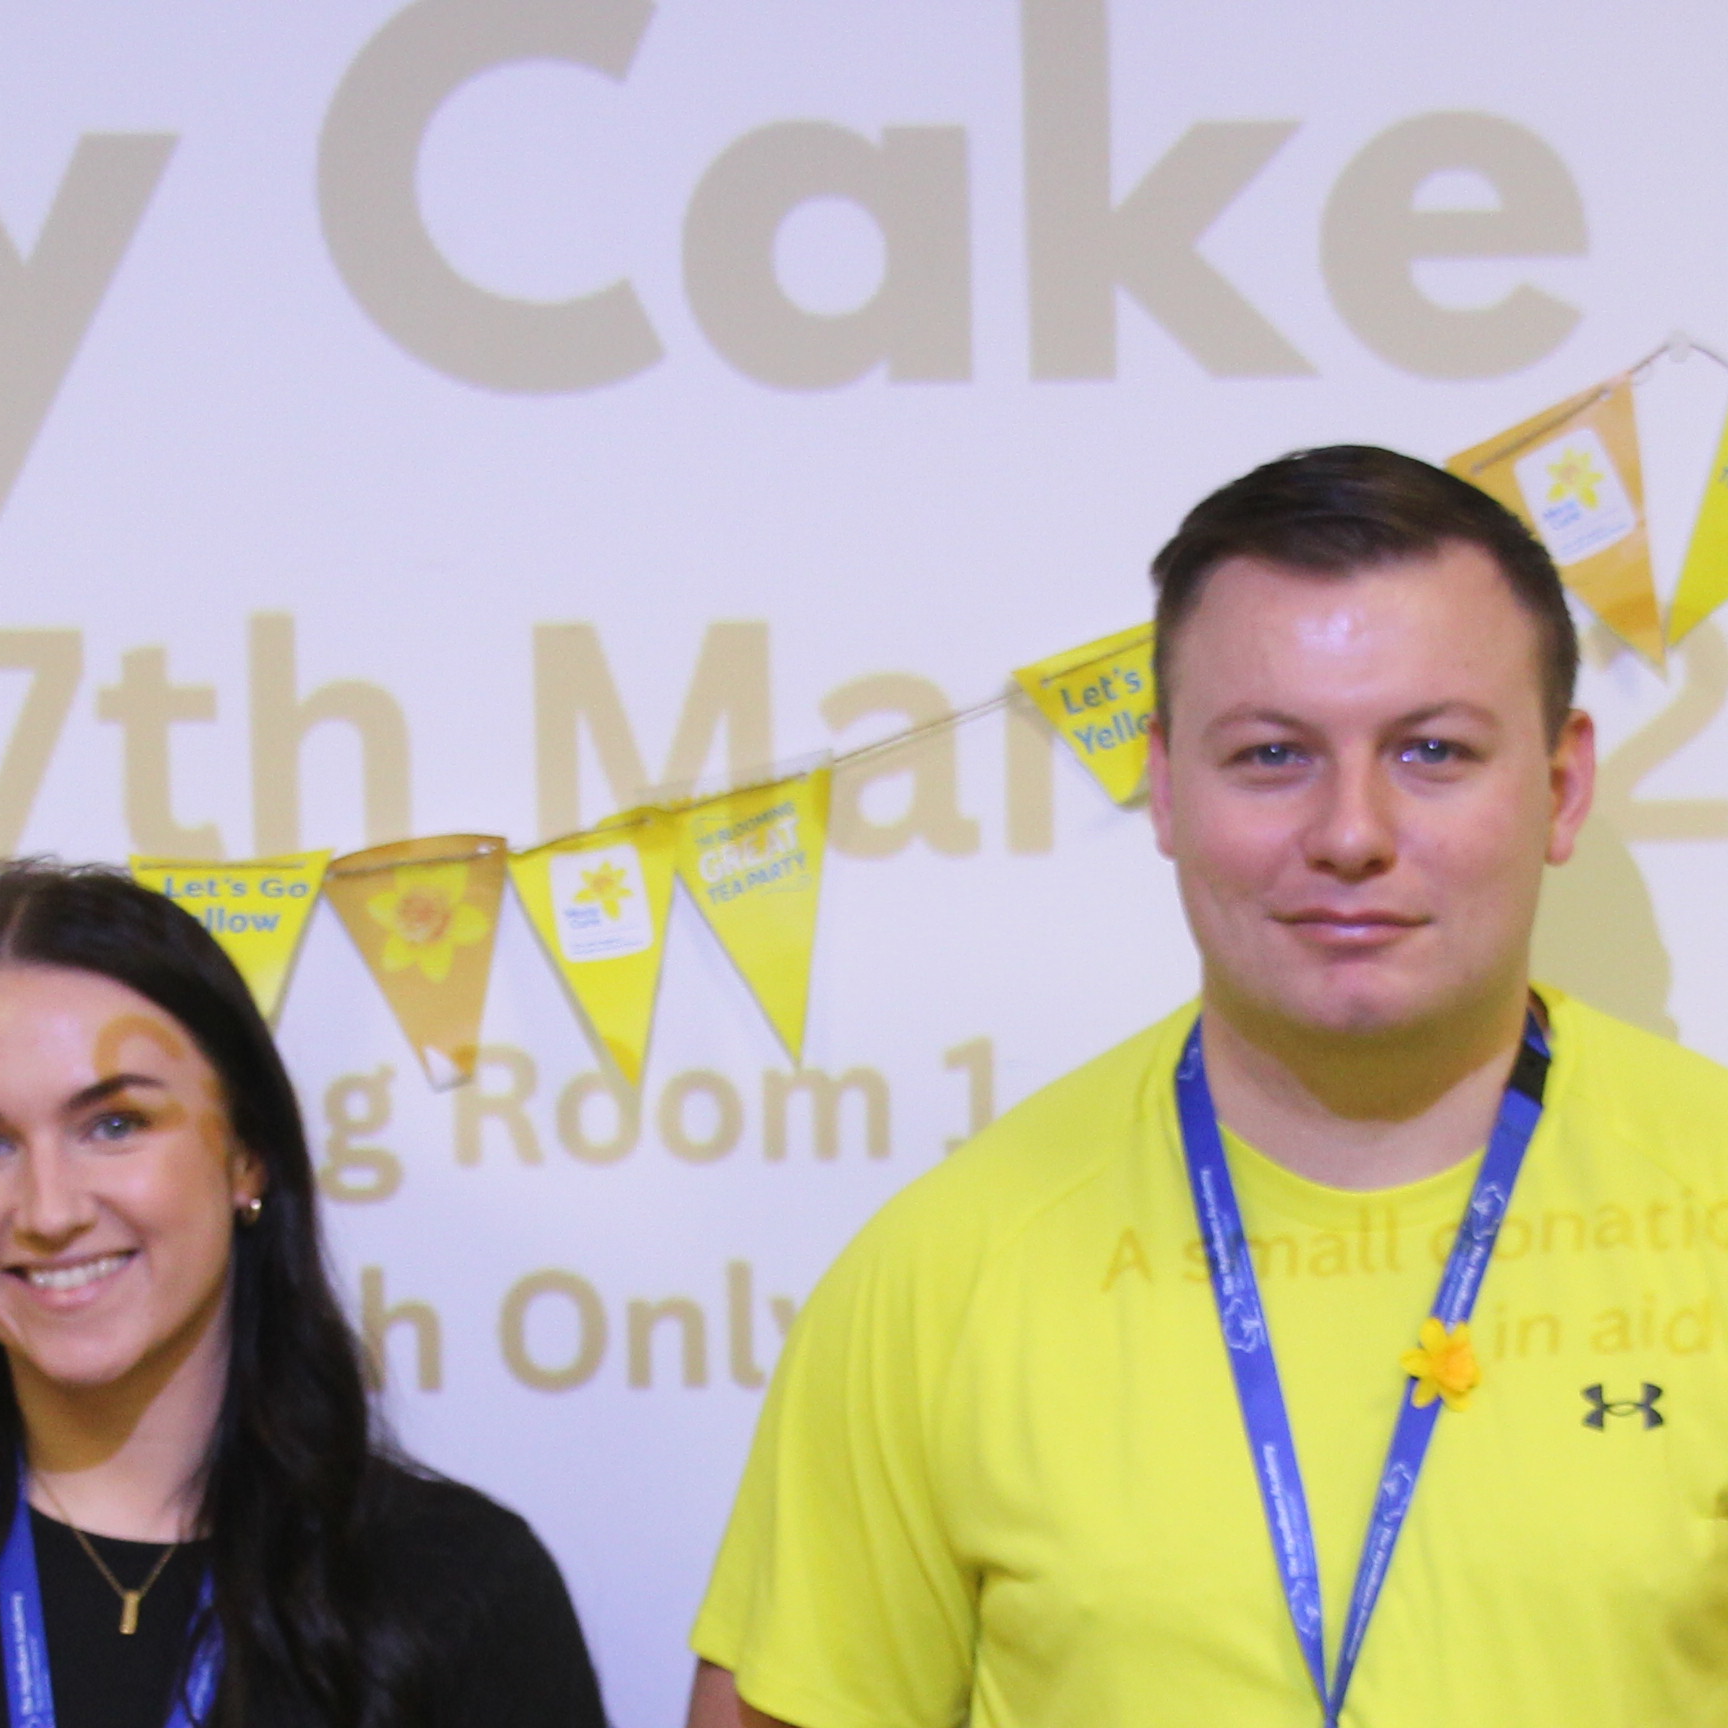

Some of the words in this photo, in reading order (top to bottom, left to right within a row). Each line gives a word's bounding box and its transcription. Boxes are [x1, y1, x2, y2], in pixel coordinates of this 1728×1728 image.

[313, 0, 1590, 396] Cake
[1059, 667, 1142, 716] Let's
[531, 621, 1067, 861] Mar
[1073, 710, 1154, 756] Yello
[698, 815, 799, 883] GREAT
[706, 879, 743, 905] TEA
[745, 851, 806, 883] PARTY
[163, 876, 249, 899] Let's
[260, 877, 310, 899] Go
[191, 906, 281, 935] llow
[453, 1044, 892, 1168] Room
[944, 1036, 996, 1158] 1
[1101, 1226, 1154, 1292] A
[1183, 1206, 1403, 1281] small
[1493, 1303, 1565, 1361] in
[1590, 1293, 1712, 1356] aid
